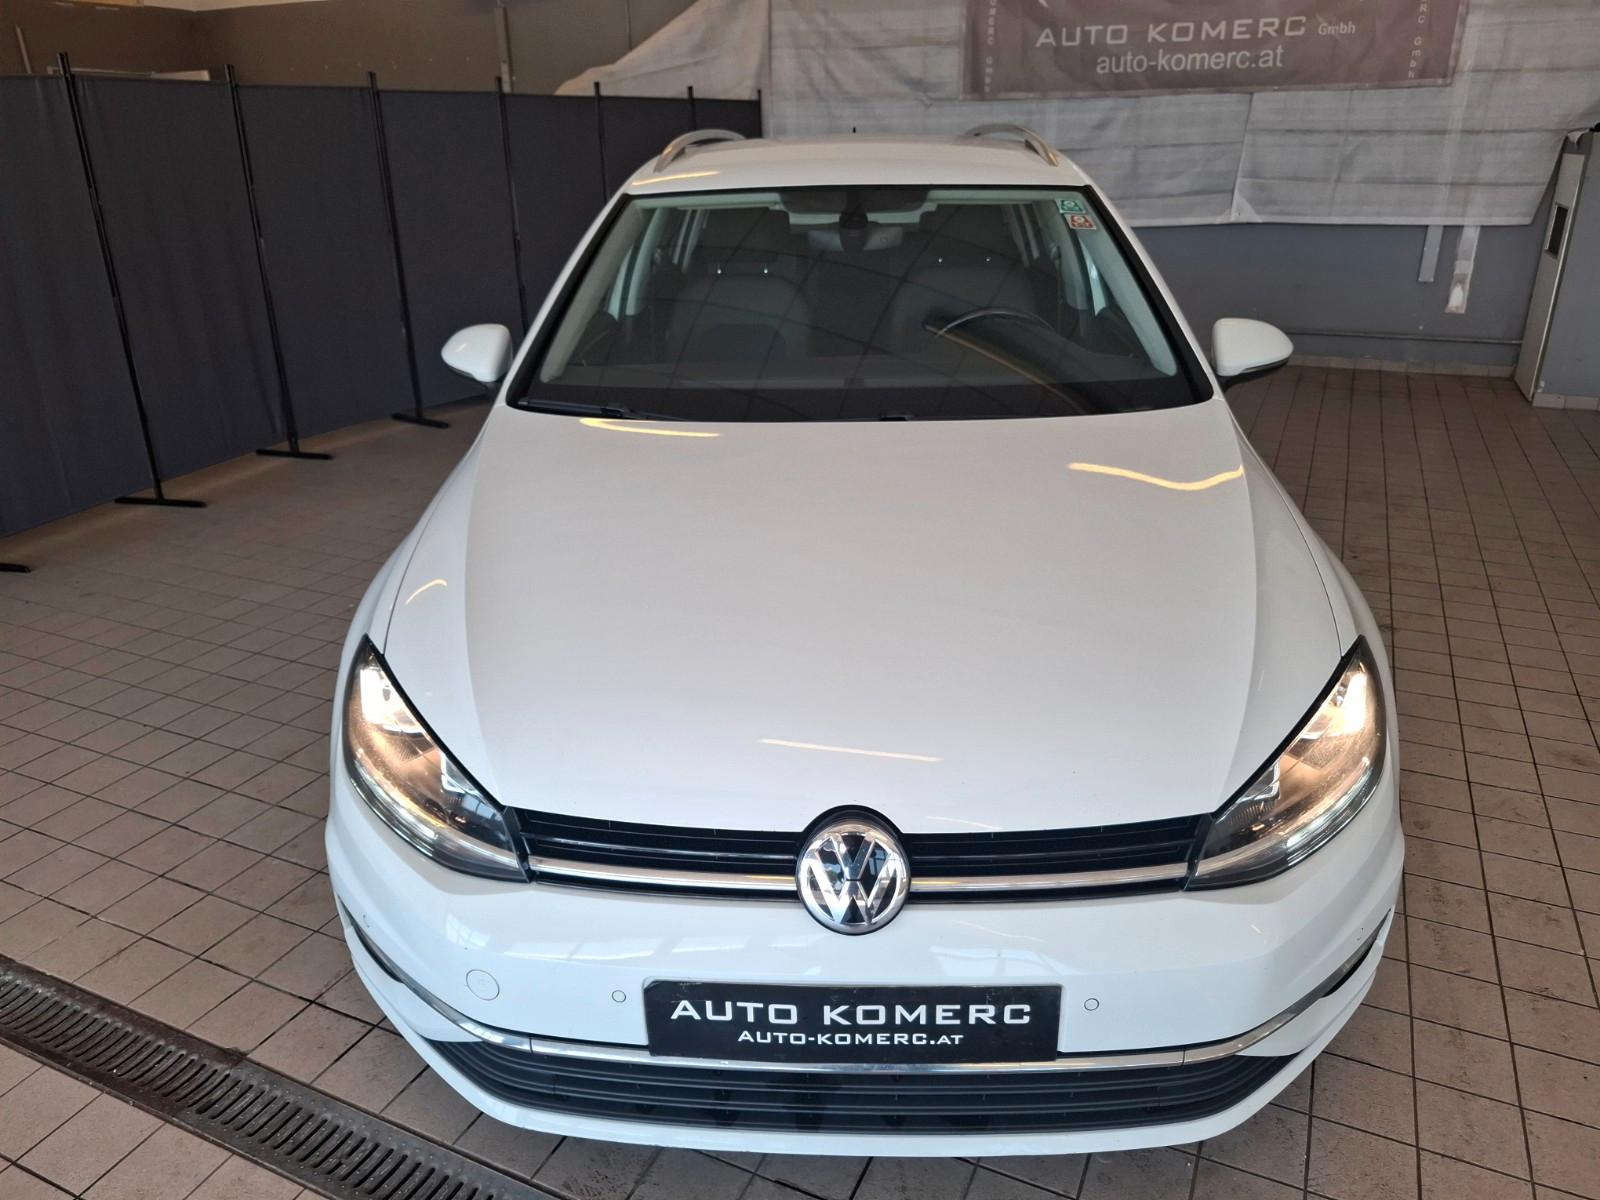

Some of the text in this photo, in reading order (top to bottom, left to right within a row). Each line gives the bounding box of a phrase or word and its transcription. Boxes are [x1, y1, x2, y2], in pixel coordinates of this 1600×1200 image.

[1036, 16, 1357, 47] AUTO KOMERC Gmbh
[1096, 45, 1284, 74] auto-komerc.at
[1407, 36, 1422, 79] Gmbh
[670, 1000, 1031, 1026] AUTO KOMERC
[736, 1030, 964, 1046] AUTO-KOMERC.AT
